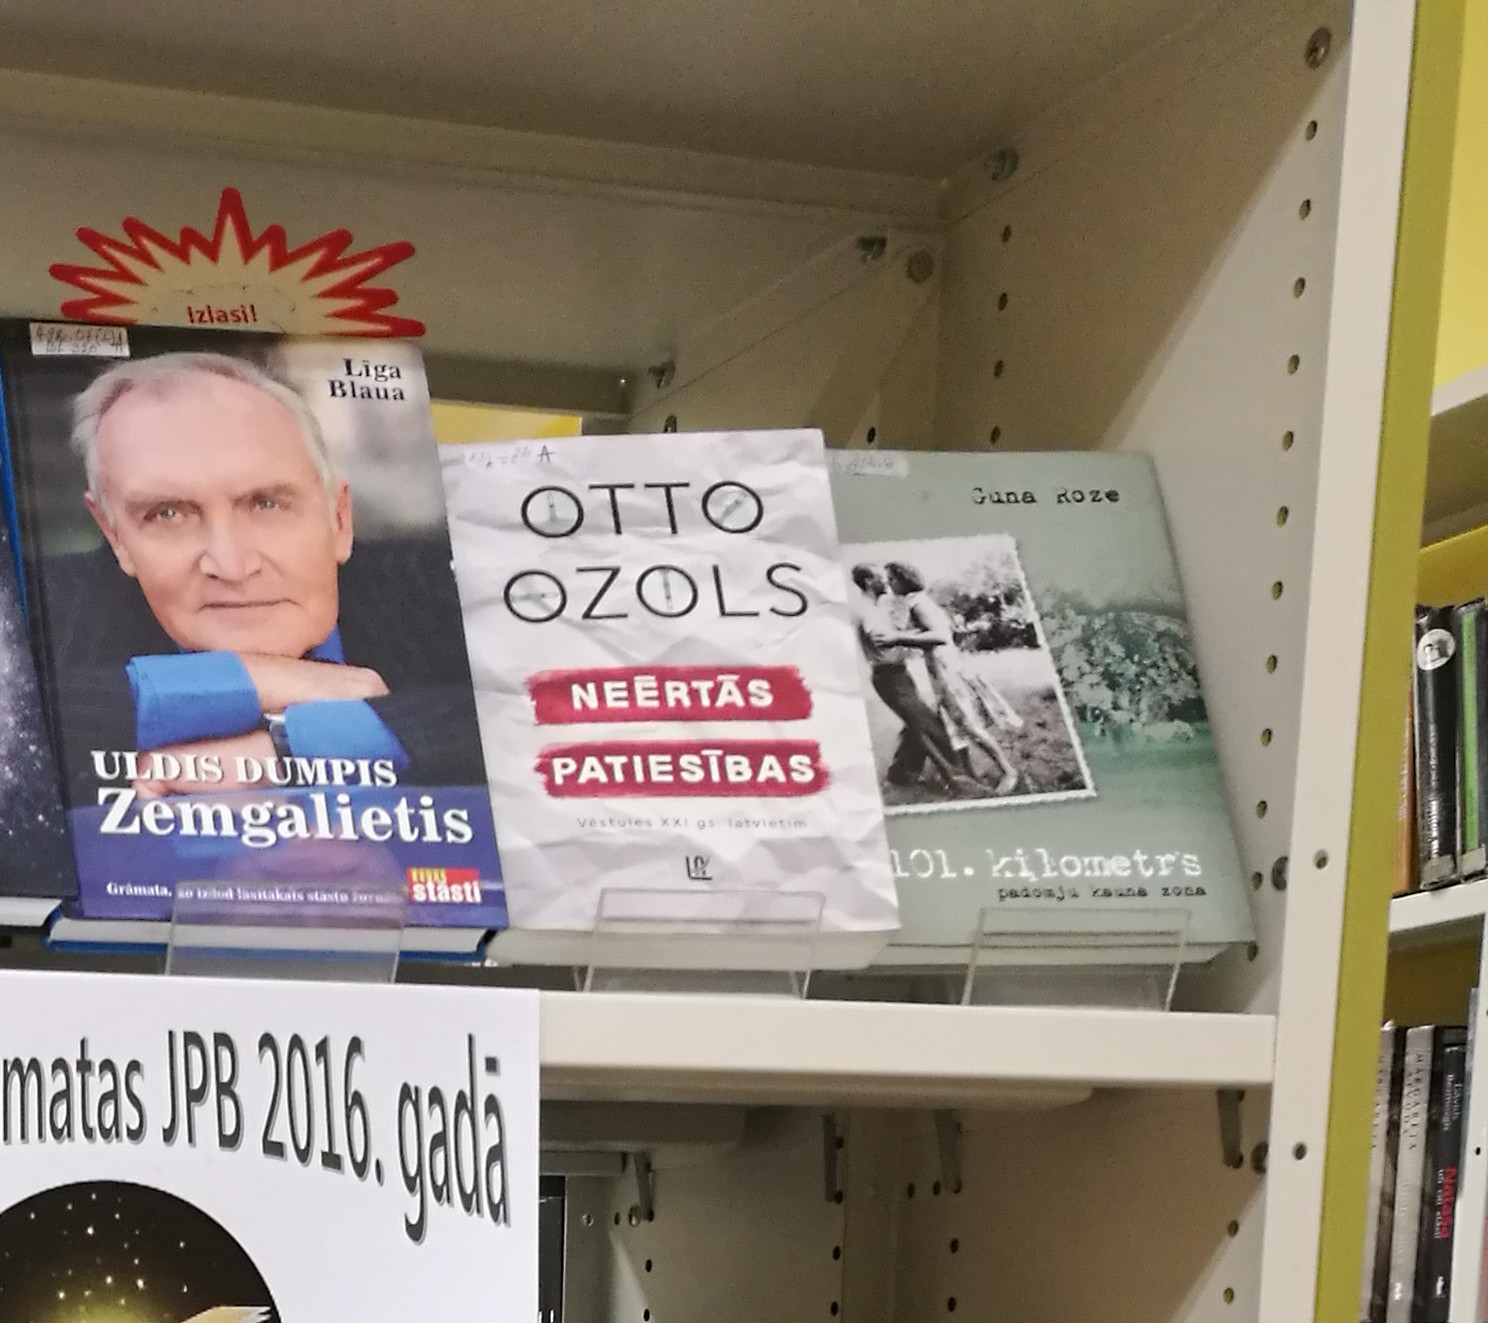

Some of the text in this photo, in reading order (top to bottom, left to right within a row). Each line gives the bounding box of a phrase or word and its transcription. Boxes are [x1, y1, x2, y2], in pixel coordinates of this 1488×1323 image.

[187, 302, 259, 327] Izlasi!
[344, 357, 403, 381] Līga
[328, 380, 406, 404] Blaua
[520, 480, 765, 539] OTTO
[1055, 486, 1121, 506] Roze
[503, 562, 809, 623] OZOLS
[571, 674, 775, 710] NEĒRTĀS
[91, 749, 398, 789] ULDIS DUMPIS
[552, 748, 815, 787] PATIESĪBAS
[99, 788, 474, 849] Zemgalietis
[986, 848, 1203, 881] kilometrs
[161, 1028, 244, 1149] JPB
[258, 1032, 388, 1188] 2016.
[396, 1032, 513, 1247] gadā
